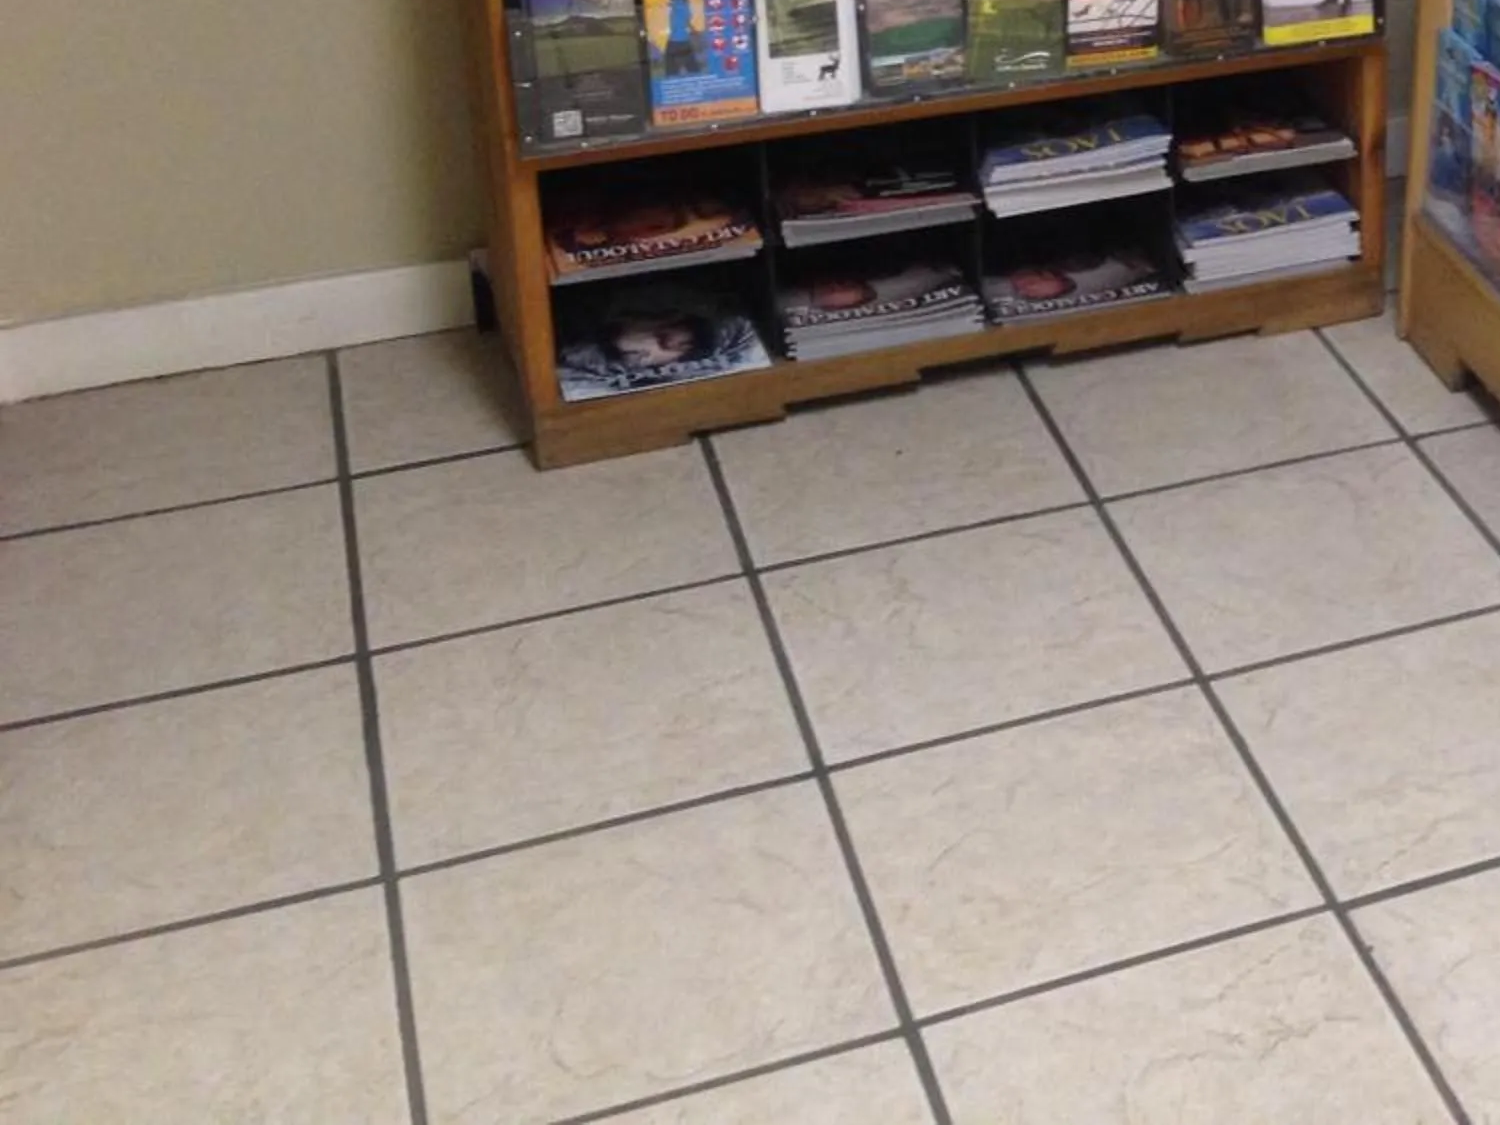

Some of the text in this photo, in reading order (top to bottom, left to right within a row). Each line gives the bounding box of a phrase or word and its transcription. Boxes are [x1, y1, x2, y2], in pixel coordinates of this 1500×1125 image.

[1118, 282, 1160, 299] ART
[784, 285, 961, 326] ART CATALOGUE
